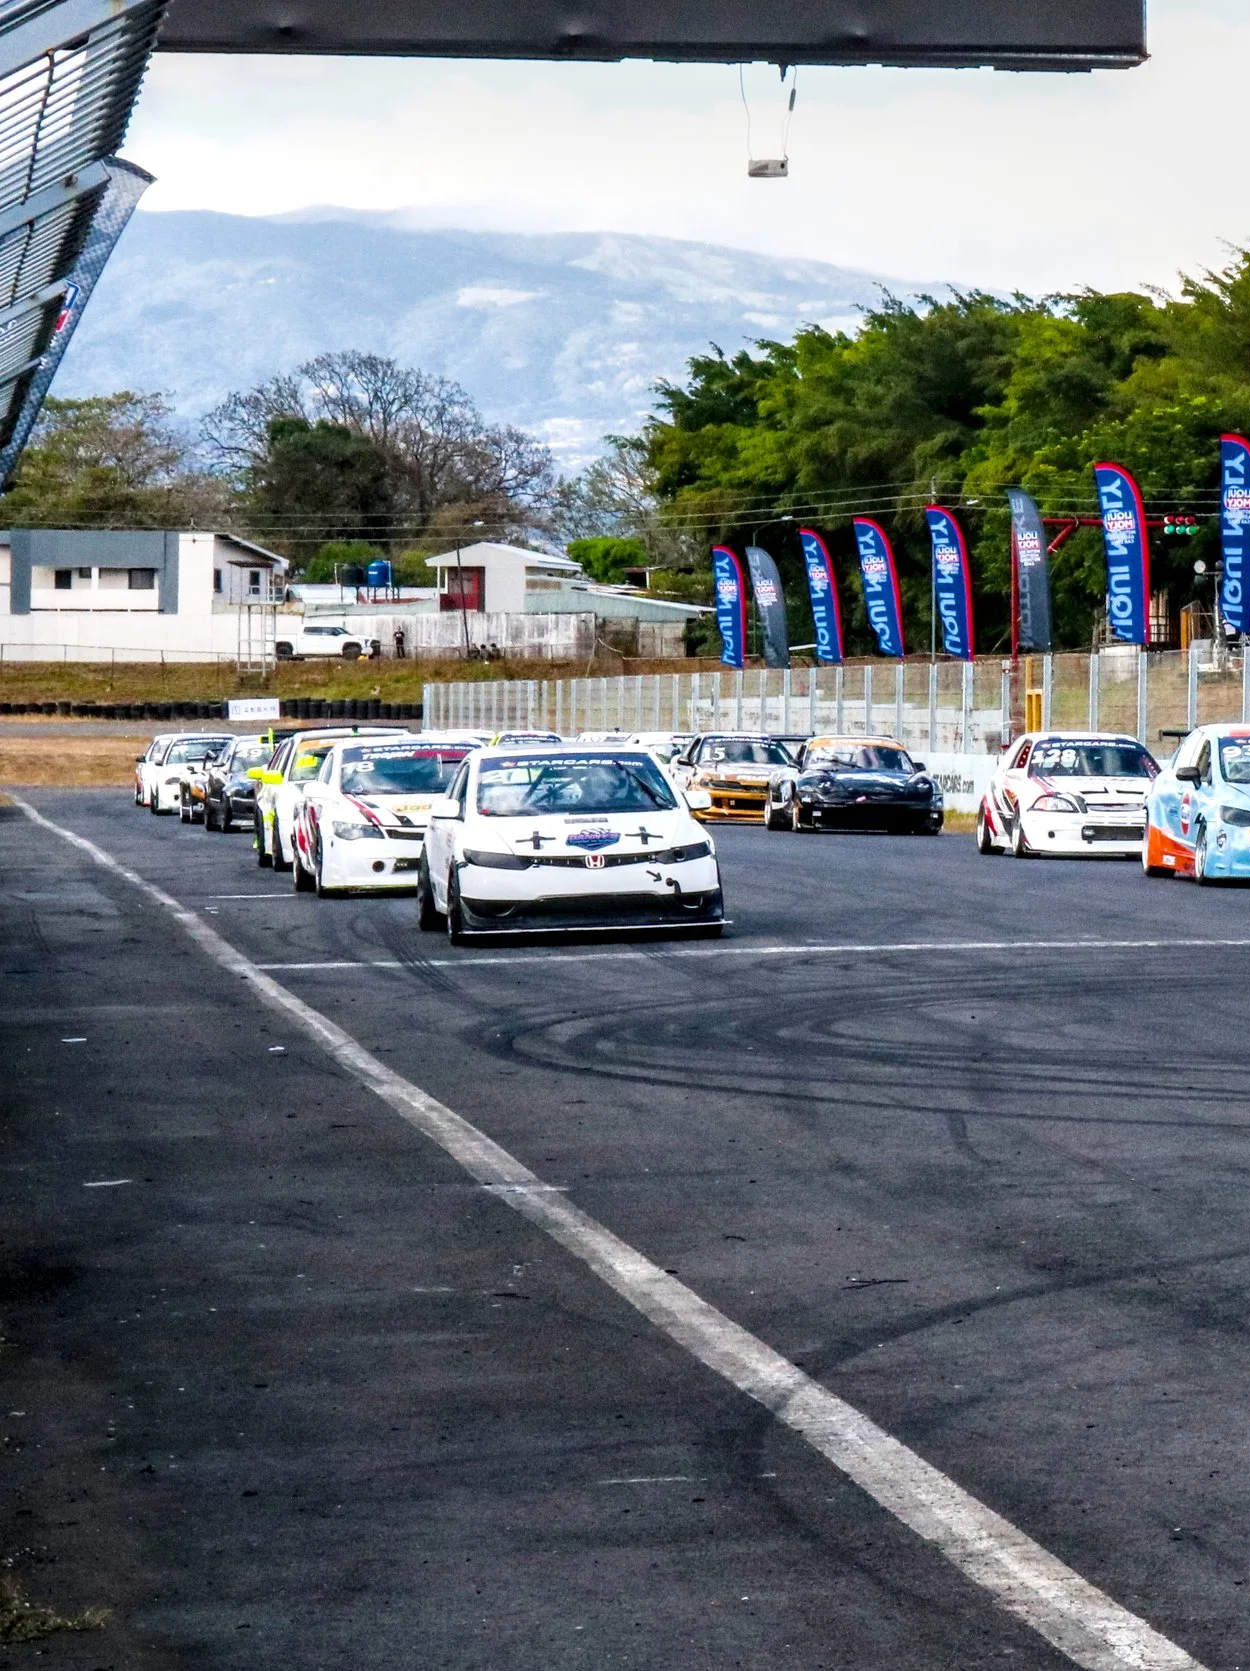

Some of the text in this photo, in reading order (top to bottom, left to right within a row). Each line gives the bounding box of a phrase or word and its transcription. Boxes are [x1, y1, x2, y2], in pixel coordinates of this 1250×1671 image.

[702, 747, 726, 761] 15
[1031, 749, 1077, 764] 128
[341, 761, 375, 774] 18
